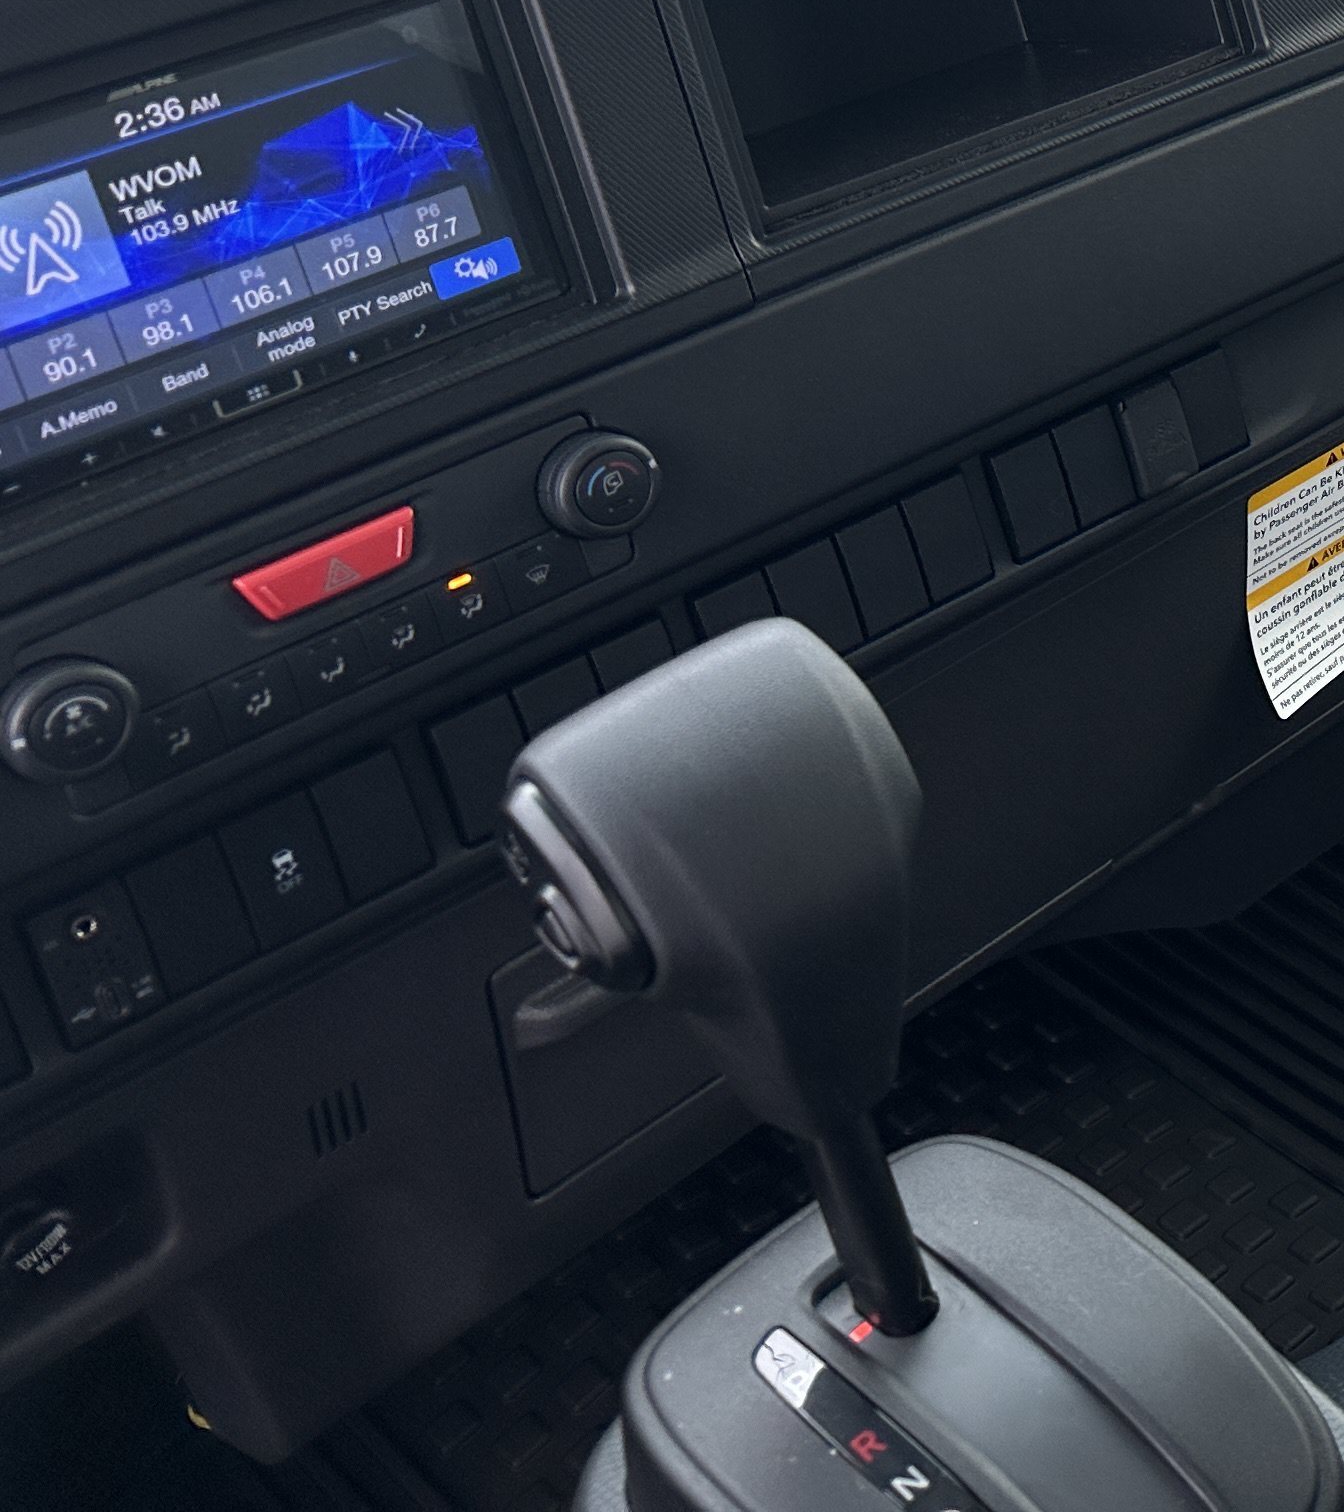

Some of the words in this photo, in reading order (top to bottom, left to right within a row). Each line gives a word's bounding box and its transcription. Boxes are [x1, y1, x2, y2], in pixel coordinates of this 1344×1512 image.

[113, 95, 186, 138] 2:36
[190, 92, 222, 116] AM
[109, 156, 203, 202] WVOM
[119, 196, 166, 226] Talk
[130, 213, 189, 247] 103.9
[192, 197, 241, 230] MHz
[416, 201, 441, 223] P6
[329, 233, 356, 254] P5
[413, 217, 459, 248] 87.7
[239, 264, 266, 286] P4
[321, 245, 383, 281] 107.9
[144, 296, 174, 320] P3
[231, 278, 294, 315] 106.1
[336, 299, 372, 326] PTY
[375, 279, 433, 312] Search
[47, 331, 78, 354] P2
[141, 313, 195, 347] 98.1
[255, 313, 316, 348] Analog
[42, 348, 99, 382] 90.1
[267, 334, 317, 363] mode
[161, 363, 209, 392] Band
[38, 398, 119, 439] A.Memo
[1253, 497, 1295, 525] Children
[1298, 484, 1317, 499] Can
[1319, 475, 1332, 487] Be
[1253, 527, 1266, 539] by
[1269, 496, 1318, 530] Passenger
[1320, 486, 1334, 500] Air
[1253, 543, 1267, 555] The
[1268, 531, 1286, 546] back
[1287, 521, 1303, 535] seat
[1324, 495, 1344, 513] safest
[1253, 550, 1274, 565] Make
[1275, 539, 1291, 552] sure
[1303, 513, 1332, 535] children
[1252, 572, 1266, 584] Not
[1289, 537, 1321, 562] removed
[1254, 610, 1268, 623] Un
[1270, 587, 1301, 613] enfant
[1303, 572, 1325, 595] peut
[1327, 560, 1344, 576] être
[1256, 610, 1291, 638] coussin
[1293, 579, 1337, 615] gonflable
[1269, 631, 1288, 648] siège
[1289, 614, 1312, 634] arrière
[1311, 629, 1327, 643] tous
[1320, 631, 1341, 650] sièges
[1263, 647, 1284, 666] moins
[1324, 656, 1338, 674] sauf
[277, 873, 303, 894] OFF
[36, 1243, 72, 1275] MAX
[849, 1429, 888, 1463] R
[891, 1464, 930, 1502] N
